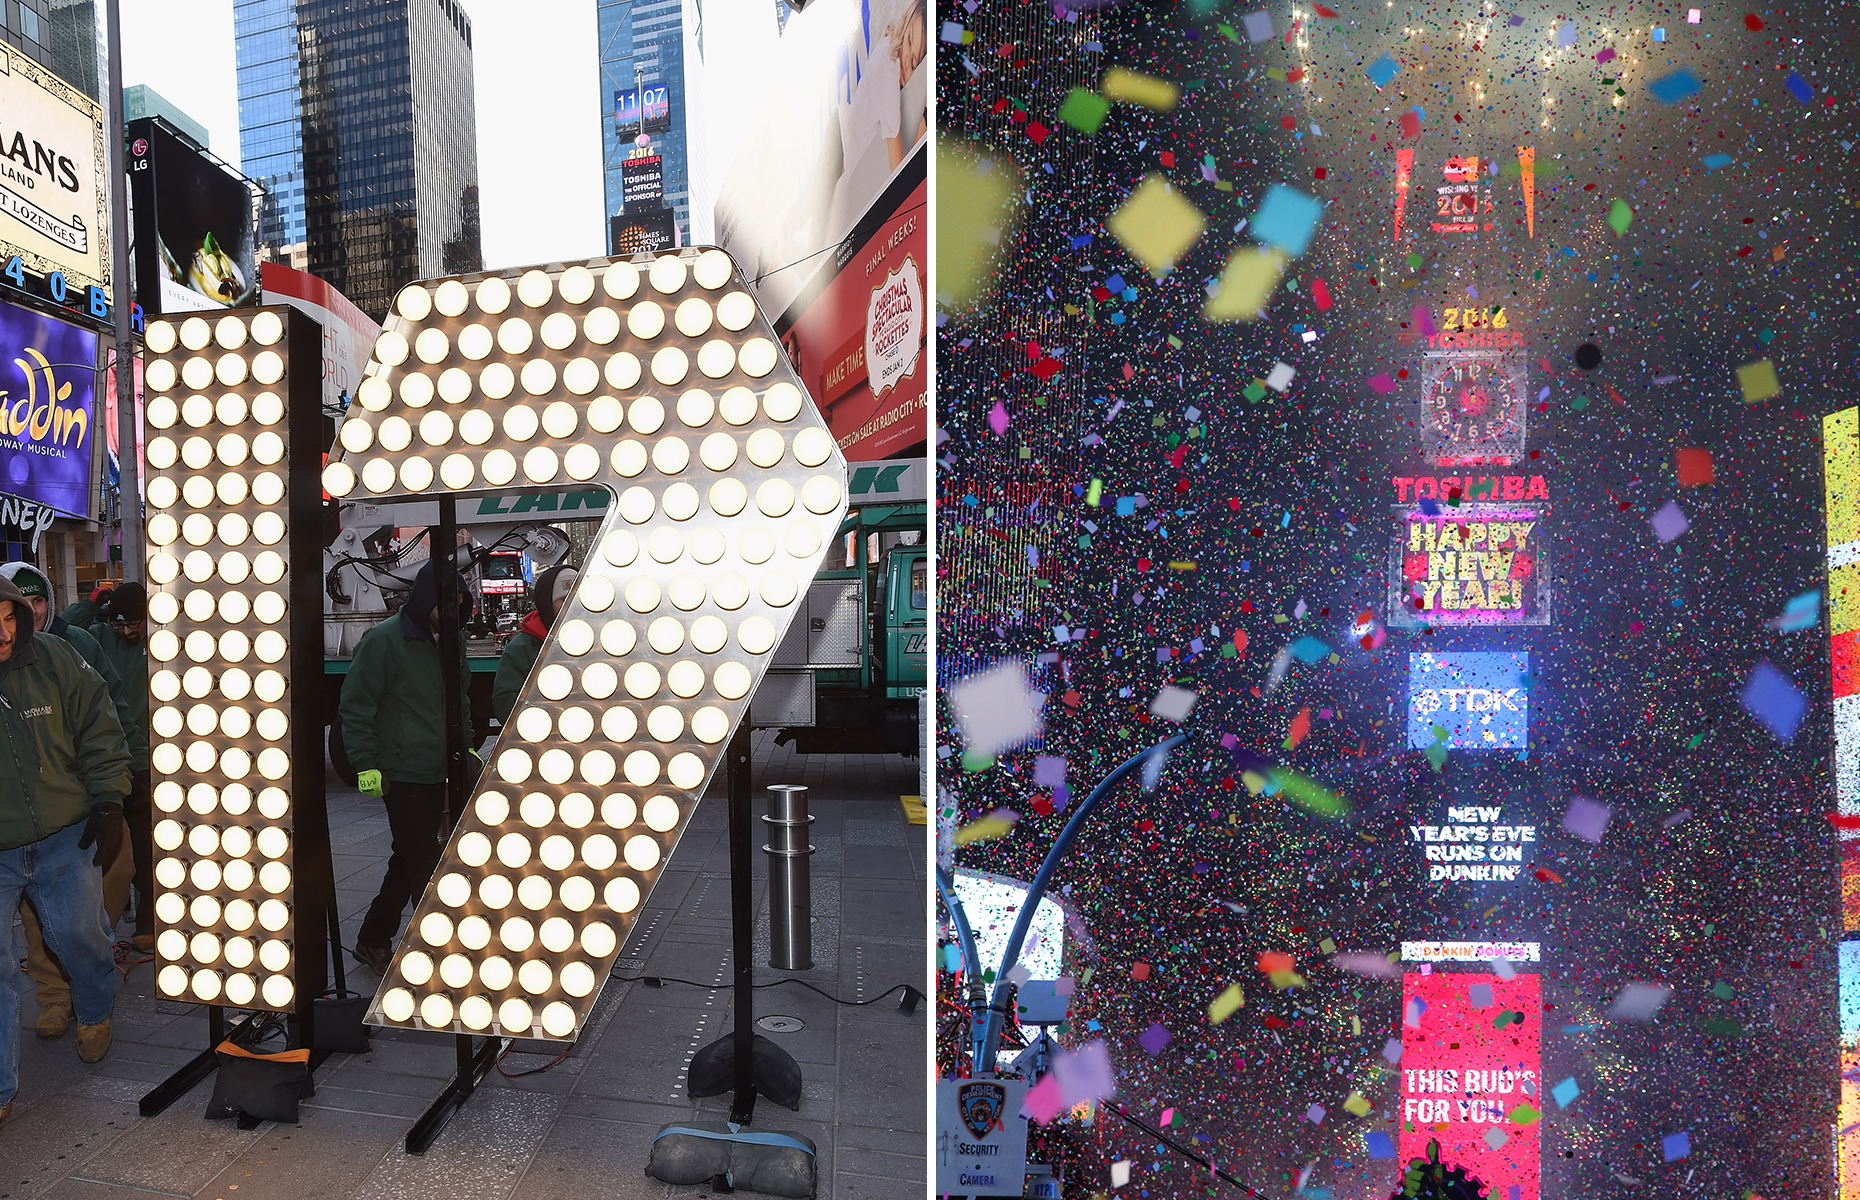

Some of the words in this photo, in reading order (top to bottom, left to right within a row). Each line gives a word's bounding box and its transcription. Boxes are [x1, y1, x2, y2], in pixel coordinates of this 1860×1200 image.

[622, 155, 662, 168] TOSHIBA
[628, 146, 655, 160] 2016
[133, 159, 148, 171] LG
[1, 163, 34, 189] LAND
[623, 172, 662, 185] TOSHIBA
[633, 182, 662, 192] OFFICIAL
[1437, 184, 1469, 195] WISING
[624, 193, 655, 203] SPONSOR
[13, 200, 76, 245] LOZENGES
[638, 231, 660, 240] TIMES
[642, 236, 670, 246] SQUARE
[630, 244, 659, 253] 2017
[865, 246, 886, 278] FINAL
[887, 215, 918, 252] WEEKS!
[168, 289, 189, 303] EVERY
[874, 278, 908, 320] CHRISTMAS
[872, 295, 913, 342] SPECTACULAR
[1443, 307, 1507, 330] 2016
[874, 317, 910, 356] ROCKETTES
[1425, 332, 1525, 349] TOSHIBA
[885, 350, 896, 361] CHASE
[826, 364, 845, 391] MAKE
[846, 345, 864, 377] TIME
[882, 364, 893, 380] ENDS
[892, 359, 900, 373] JAN
[1468, 364, 1482, 379] 12
[1436, 396, 1447, 409] 9
[1502, 394, 1511, 408] 3
[852, 429, 860, 445] ON
[860, 422, 873, 440] SALE
[873, 417, 881, 434] AT
[880, 407, 899, 430] RADIO
[900, 399, 914, 419] CITY
[1468, 425, 1479, 438] 6
[28, 444, 66, 459] MUSICAL
[1392, 475, 1550, 502] TOSHIBA
[0, 496, 55, 554] NEY
[1410, 521, 1537, 551] HAPPY
[1428, 550, 1515, 580] NEW
[1415, 579, 1522, 610] YEAR!
[1440, 688, 1520, 711] TDK
[1448, 806, 1502, 823] NEW
[1410, 825, 1489, 842] YEAR'S
[1492, 826, 1536, 842] EVE
[1425, 845, 1486, 862] RUNS
[1489, 845, 1523, 862] ON
[1429, 864, 1522, 881] DUNKIN'
[1476, 946, 1526, 957] DONUTS
[970, 1084, 996, 1092] POLICE
[1404, 1069, 1459, 1094] THIS
[1465, 1069, 1536, 1095] BUD'S
[961, 1090, 1003, 1102] DEPARTMENT
[961, 1106, 970, 1121] CITY
[968, 1122, 976, 1130] OF
[992, 1104, 1003, 1120] YORK
[1404, 1098, 1450, 1123] FOR
[959, 1142, 999, 1155] SECURITY
[960, 1173, 995, 1186] CAMERA
